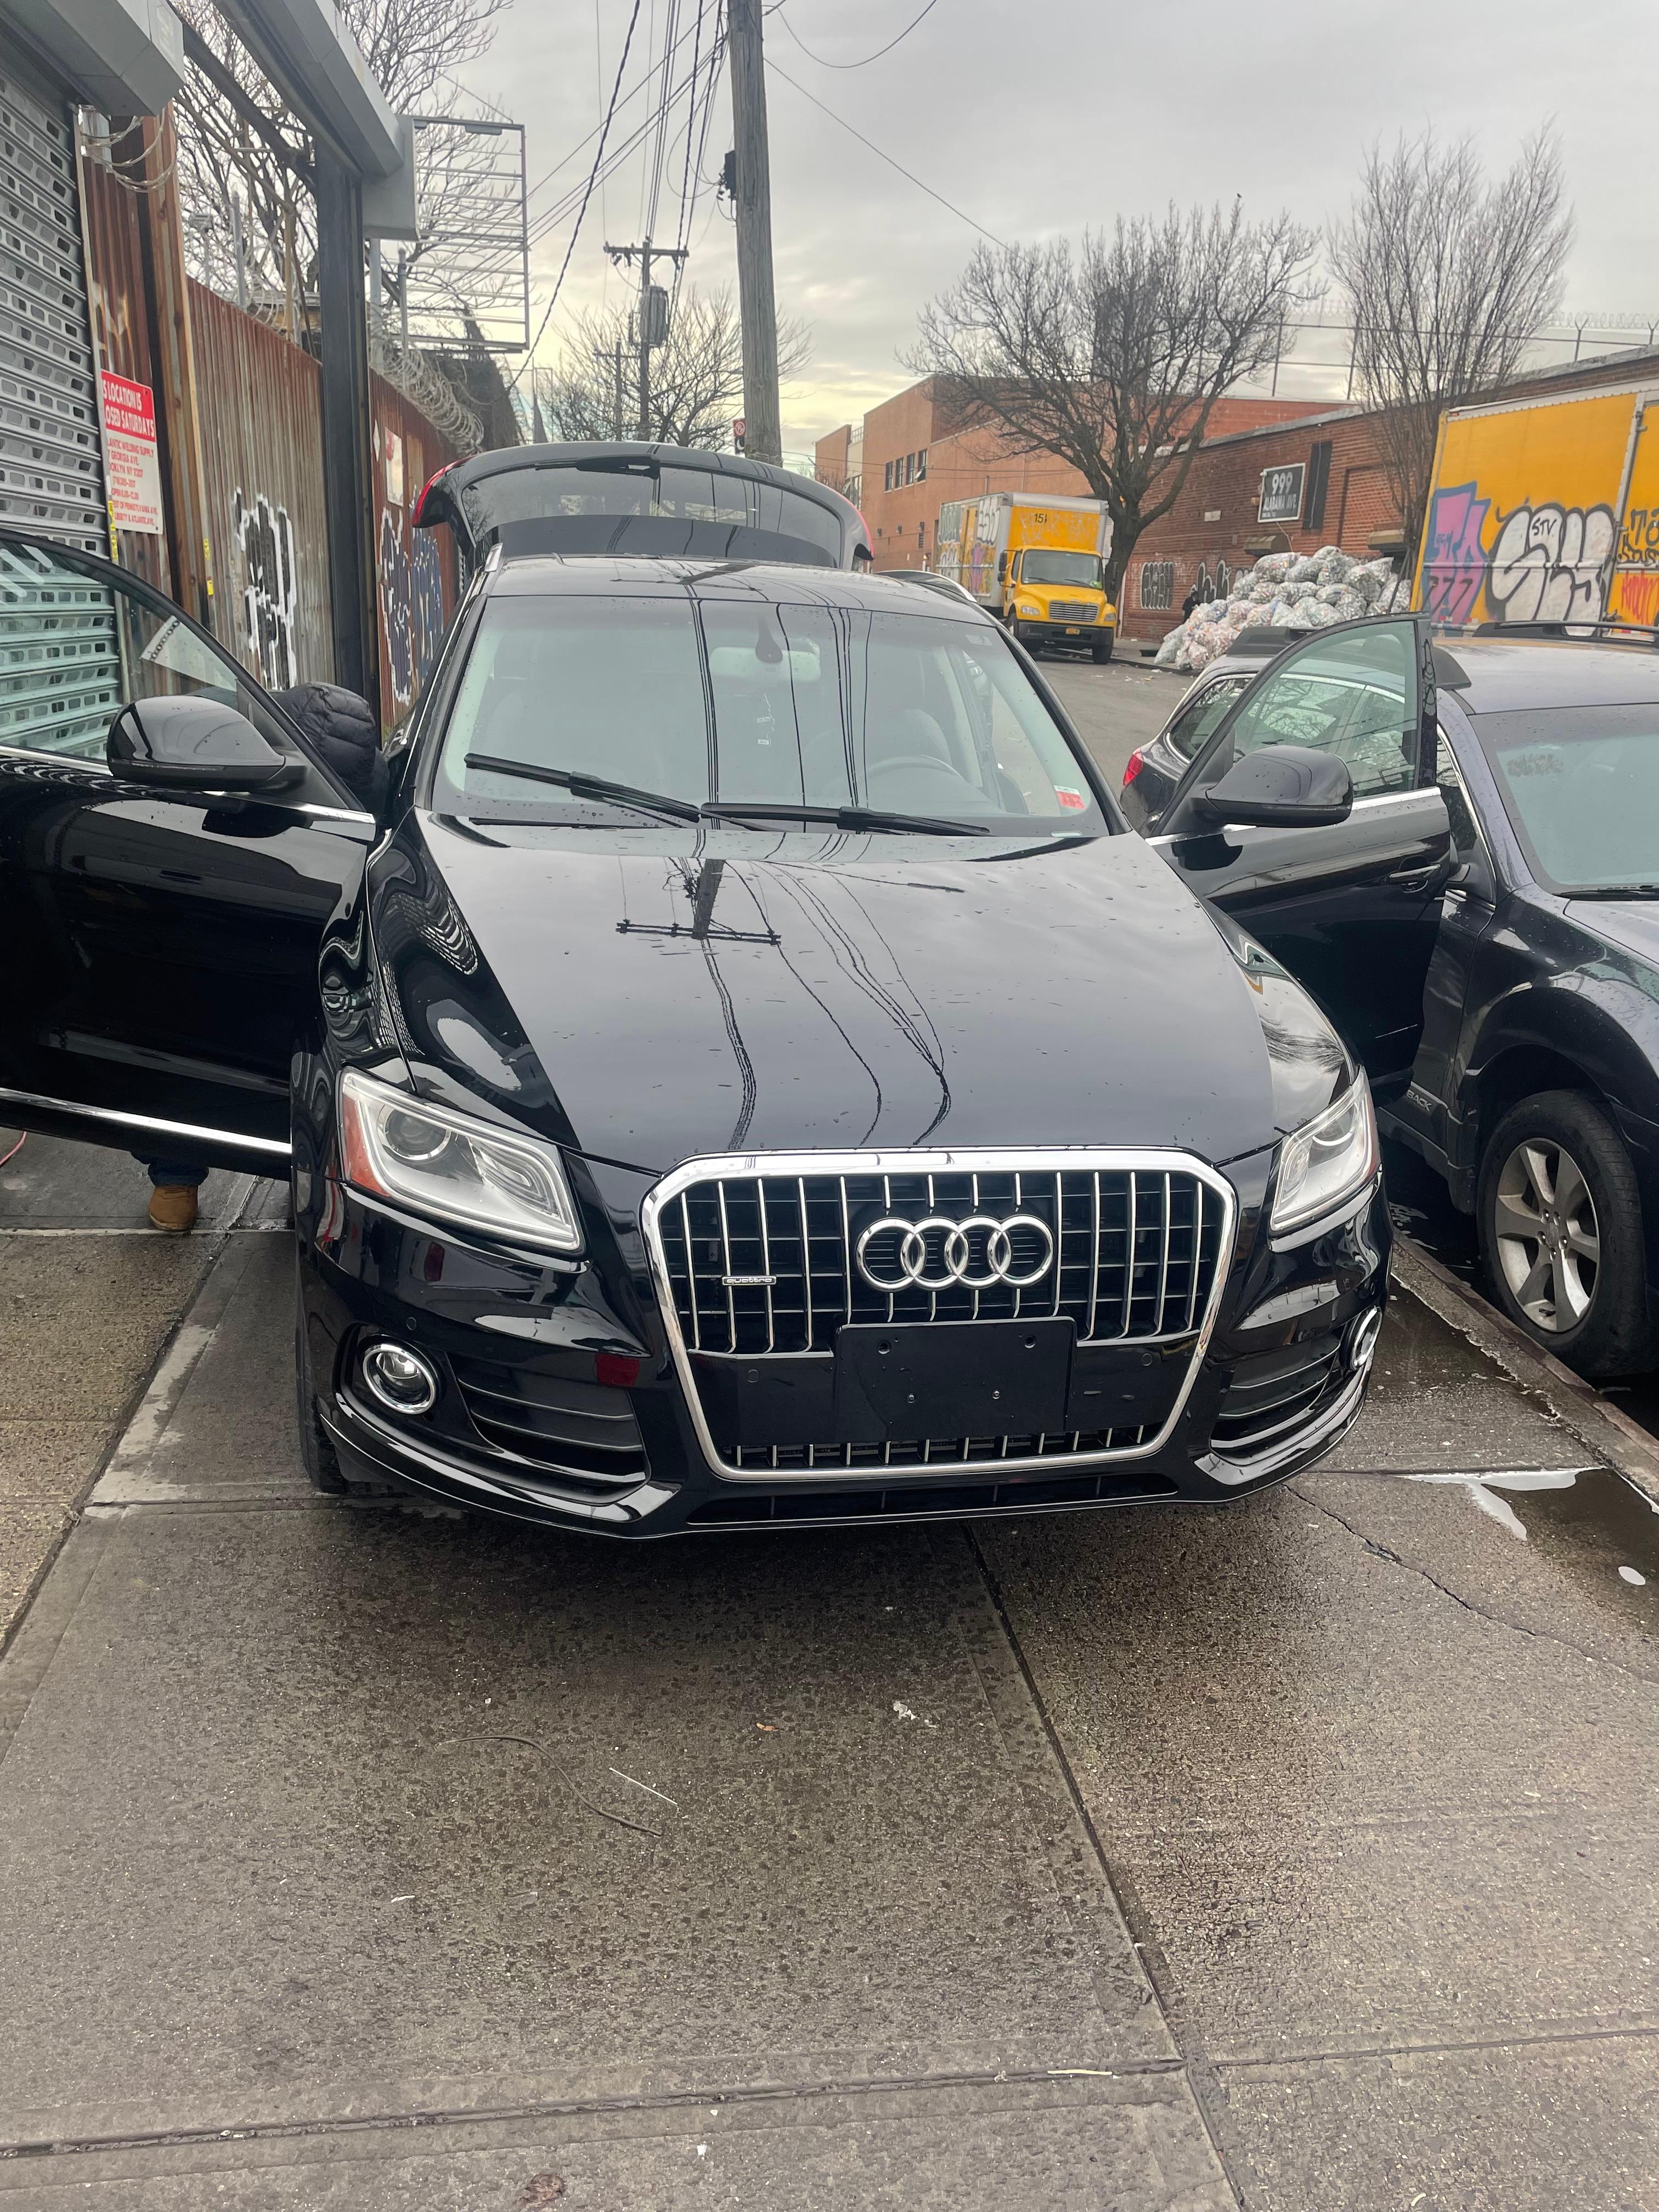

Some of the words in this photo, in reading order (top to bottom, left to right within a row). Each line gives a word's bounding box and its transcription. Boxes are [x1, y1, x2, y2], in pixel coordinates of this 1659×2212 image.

[108, 381, 137, 409] LOCATION
[136, 391, 142, 411] IS
[105, 404, 121, 427] OSED
[121, 409, 155, 437] SATURDAYS
[140, 446, 154, 458] SUPPLY
[1272, 472, 1293, 495] 999
[1263, 495, 1285, 511] ALABAMA
[1034, 513, 1047, 523] 151
